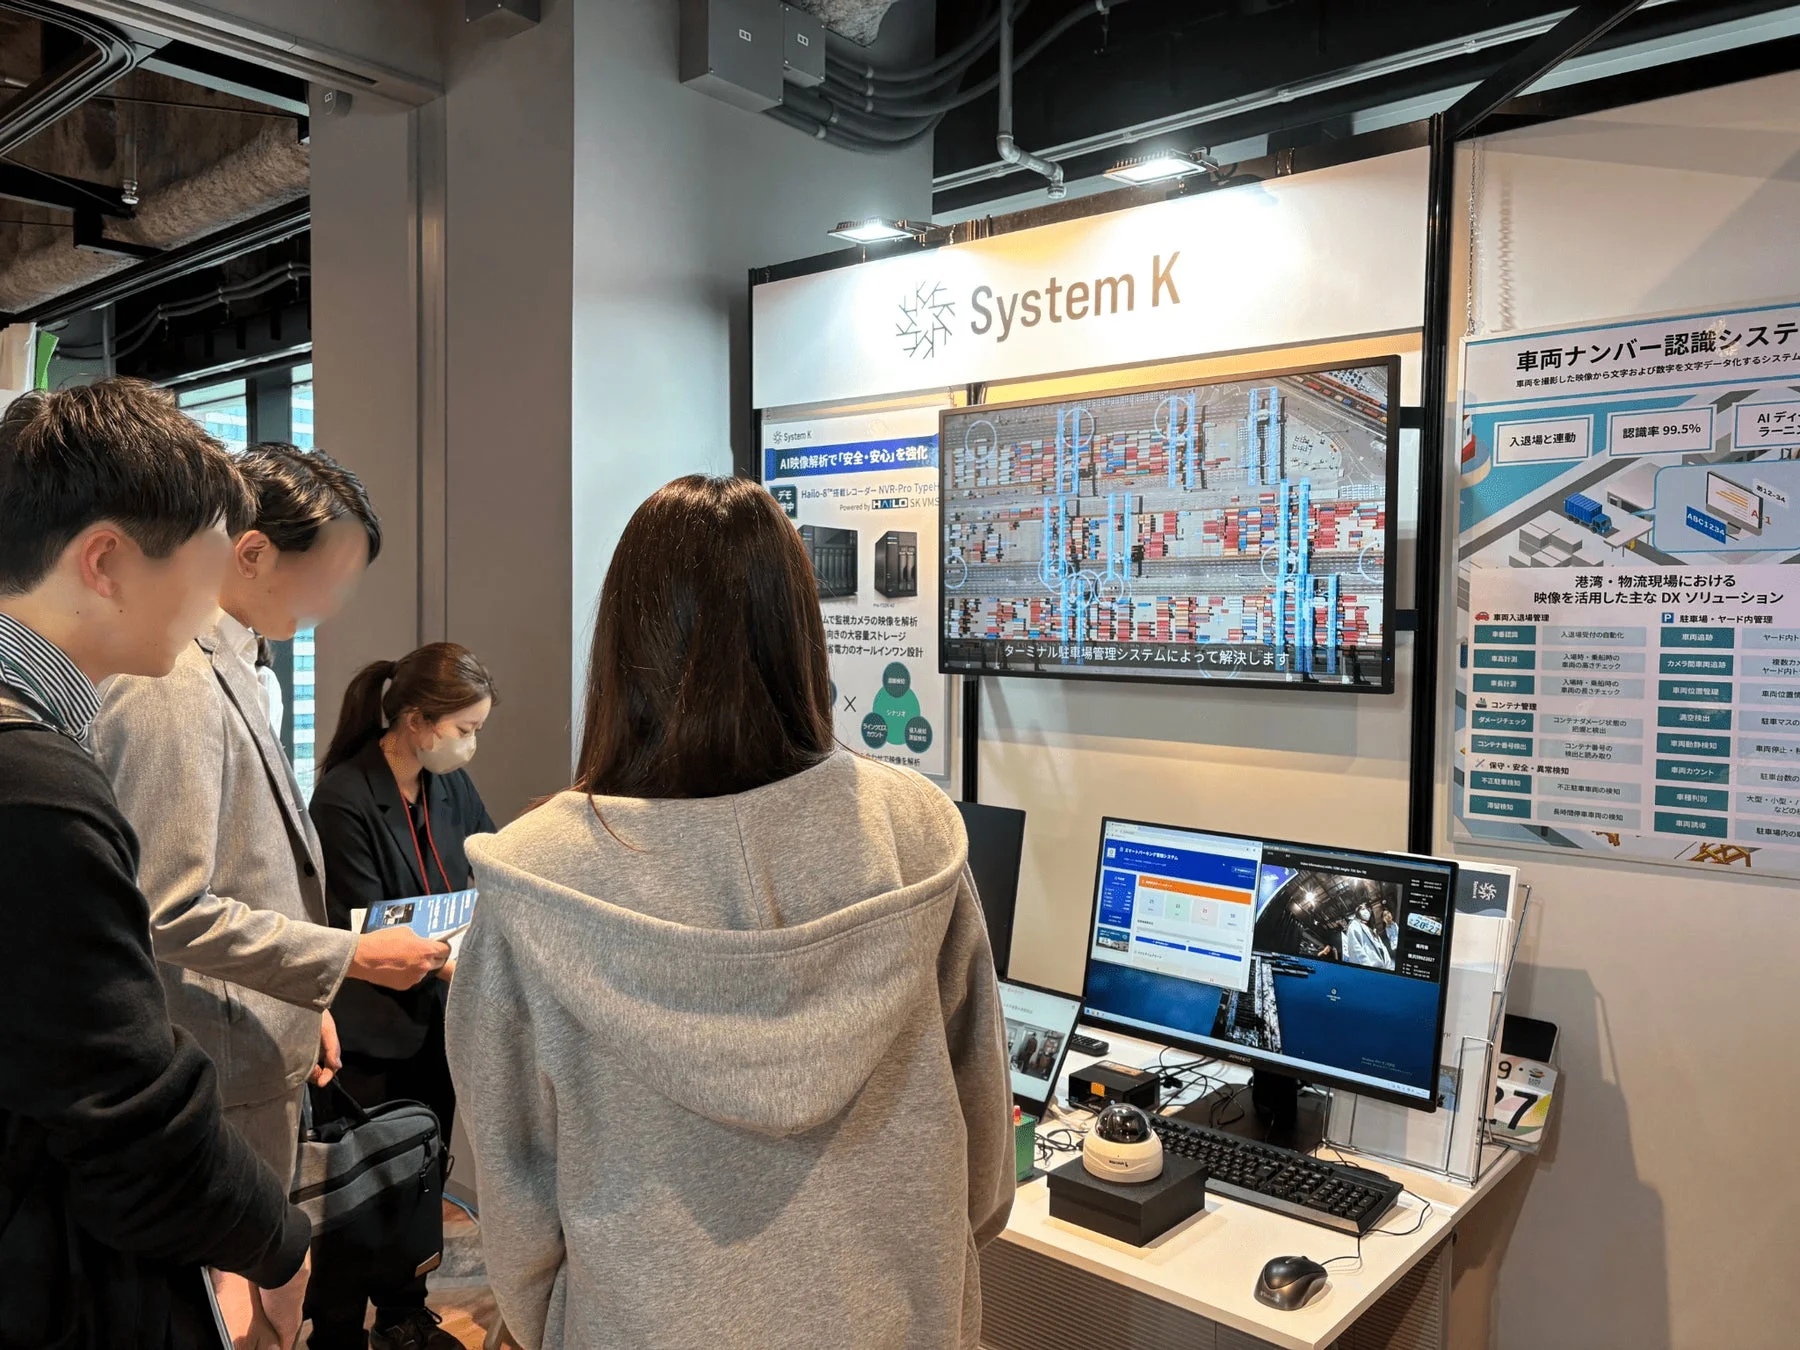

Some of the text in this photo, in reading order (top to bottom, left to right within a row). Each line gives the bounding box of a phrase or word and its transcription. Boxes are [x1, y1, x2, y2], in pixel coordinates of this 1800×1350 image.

[970, 251, 1181, 343] System K
[1516, 322, 1799, 372] 車両ナンバー認識システ
[1757, 413, 1770, 424] AI
[783, 430, 812, 442] System K
[1622, 423, 1701, 439] 認識率 99.5%
[1509, 432, 1577, 447] 入退場と連動
[780, 445, 928, 470] AI映像解析で「安全・安心」を強化
[878, 483, 912, 494] NVR-Pro
[839, 497, 939, 512] Powered by HAILO SK VMS
[1687, 512, 1725, 536] ABC1234
[1575, 574, 1736, 589] 港湾・物流現場における
[1534, 591, 1784, 605] 映像を活用した主な DX ソリューション
[1493, 613, 1550, 622] 車両入退場管理
[1679, 614, 1773, 624] 駐車場・ヤード内管理
[1560, 631, 1625, 639] 入退場受付の自動化
[1004, 644, 1290, 667] ターミナル駐車場管理システムによって解決します
[1561, 661, 1621, 670] 車両の高さチェック
[1561, 687, 1621, 696] 車両の長さチェック
[1491, 701, 1537, 711] コンテナ管理
[1478, 716, 1527, 726] ダメージチェック
[1553, 716, 1627, 727] コンテナダメージ状態の
[1564, 743, 1613, 752] コンテナ番号の
[1489, 762, 1570, 775] 保守・安全・異常検知
[1671, 766, 1715, 776] 車両カウント
[1557, 784, 1621, 795] 不正駐車車両の検知
[1553, 808, 1624, 822] 長時間停車車両の検知
[1497, 1060, 1512, 1080] 9
